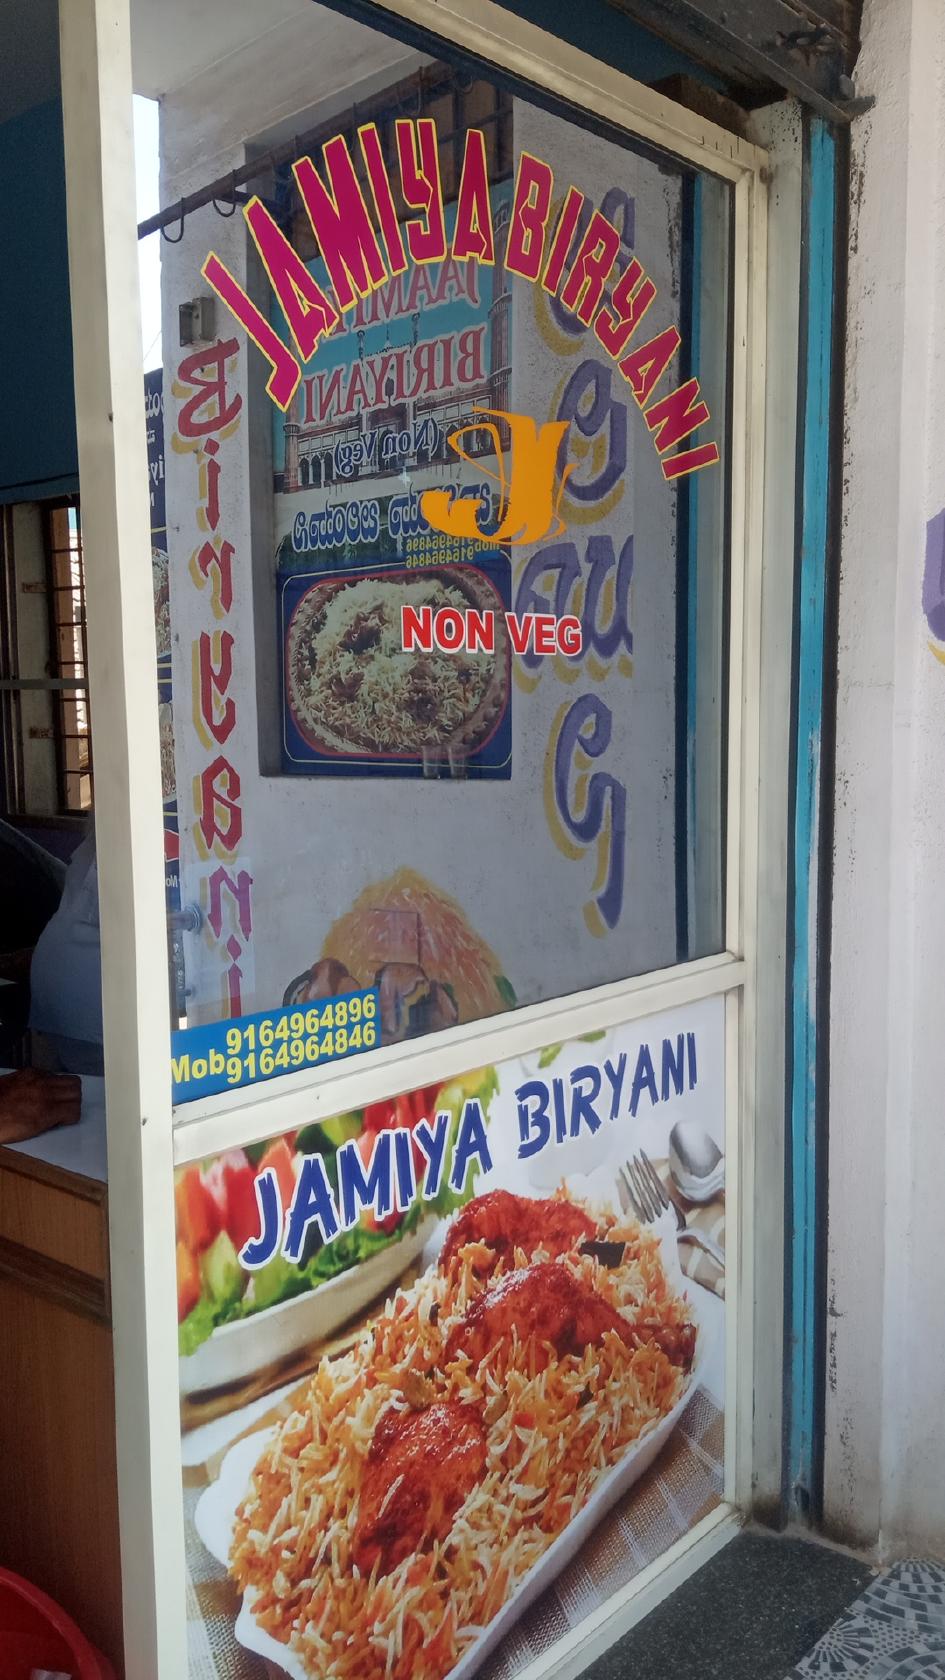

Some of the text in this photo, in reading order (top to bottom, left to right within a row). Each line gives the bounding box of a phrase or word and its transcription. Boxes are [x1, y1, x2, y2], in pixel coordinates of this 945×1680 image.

[201, 118, 719, 481] JAMIYA BIRYANI
[401, 606, 582, 656] NON VEG
[171, 1021, 377, 1083] Mob 9164964846
[226, 993, 377, 1055] 9164964896
[239, 1031, 698, 1269] JAMIYA BIRYANI
